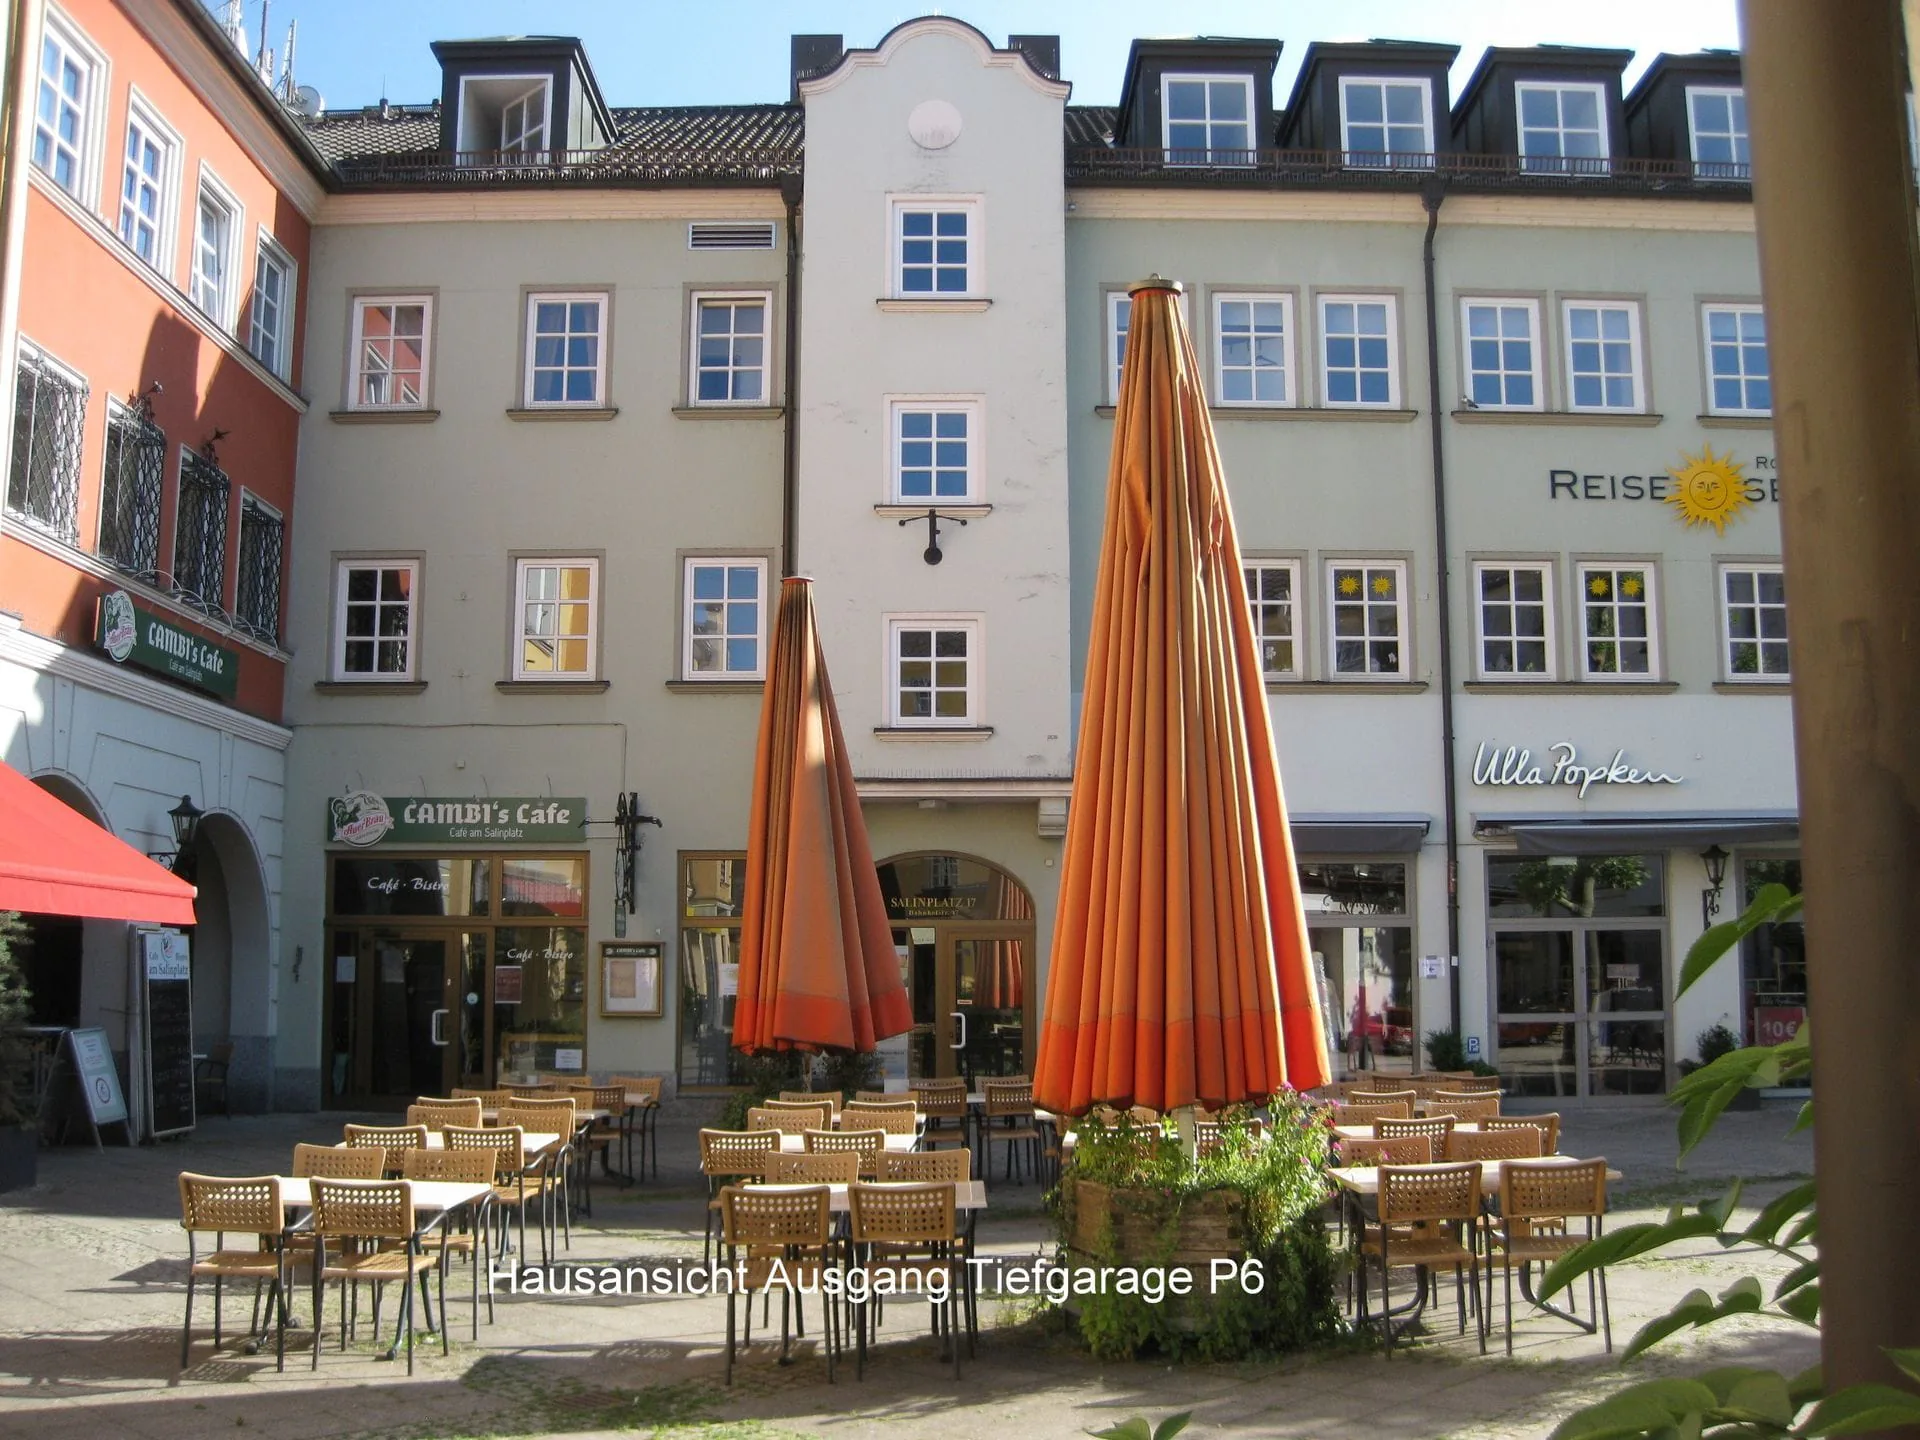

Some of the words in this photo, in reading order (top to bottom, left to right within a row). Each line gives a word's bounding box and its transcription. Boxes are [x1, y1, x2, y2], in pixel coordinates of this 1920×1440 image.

[1549, 469, 1670, 500] REISE
[1472, 741, 1544, 785] Ulla
[1549, 741, 1684, 799] Popken
[516, 802, 570, 824] Cafe
[469, 829, 483, 838] am
[484, 827, 524, 840] Salinplatz
[367, 877, 400, 895] Café
[411, 877, 449, 891] Bistro
[891, 897, 962, 908] SALINPLATZ
[506, 948, 533, 961] Café
